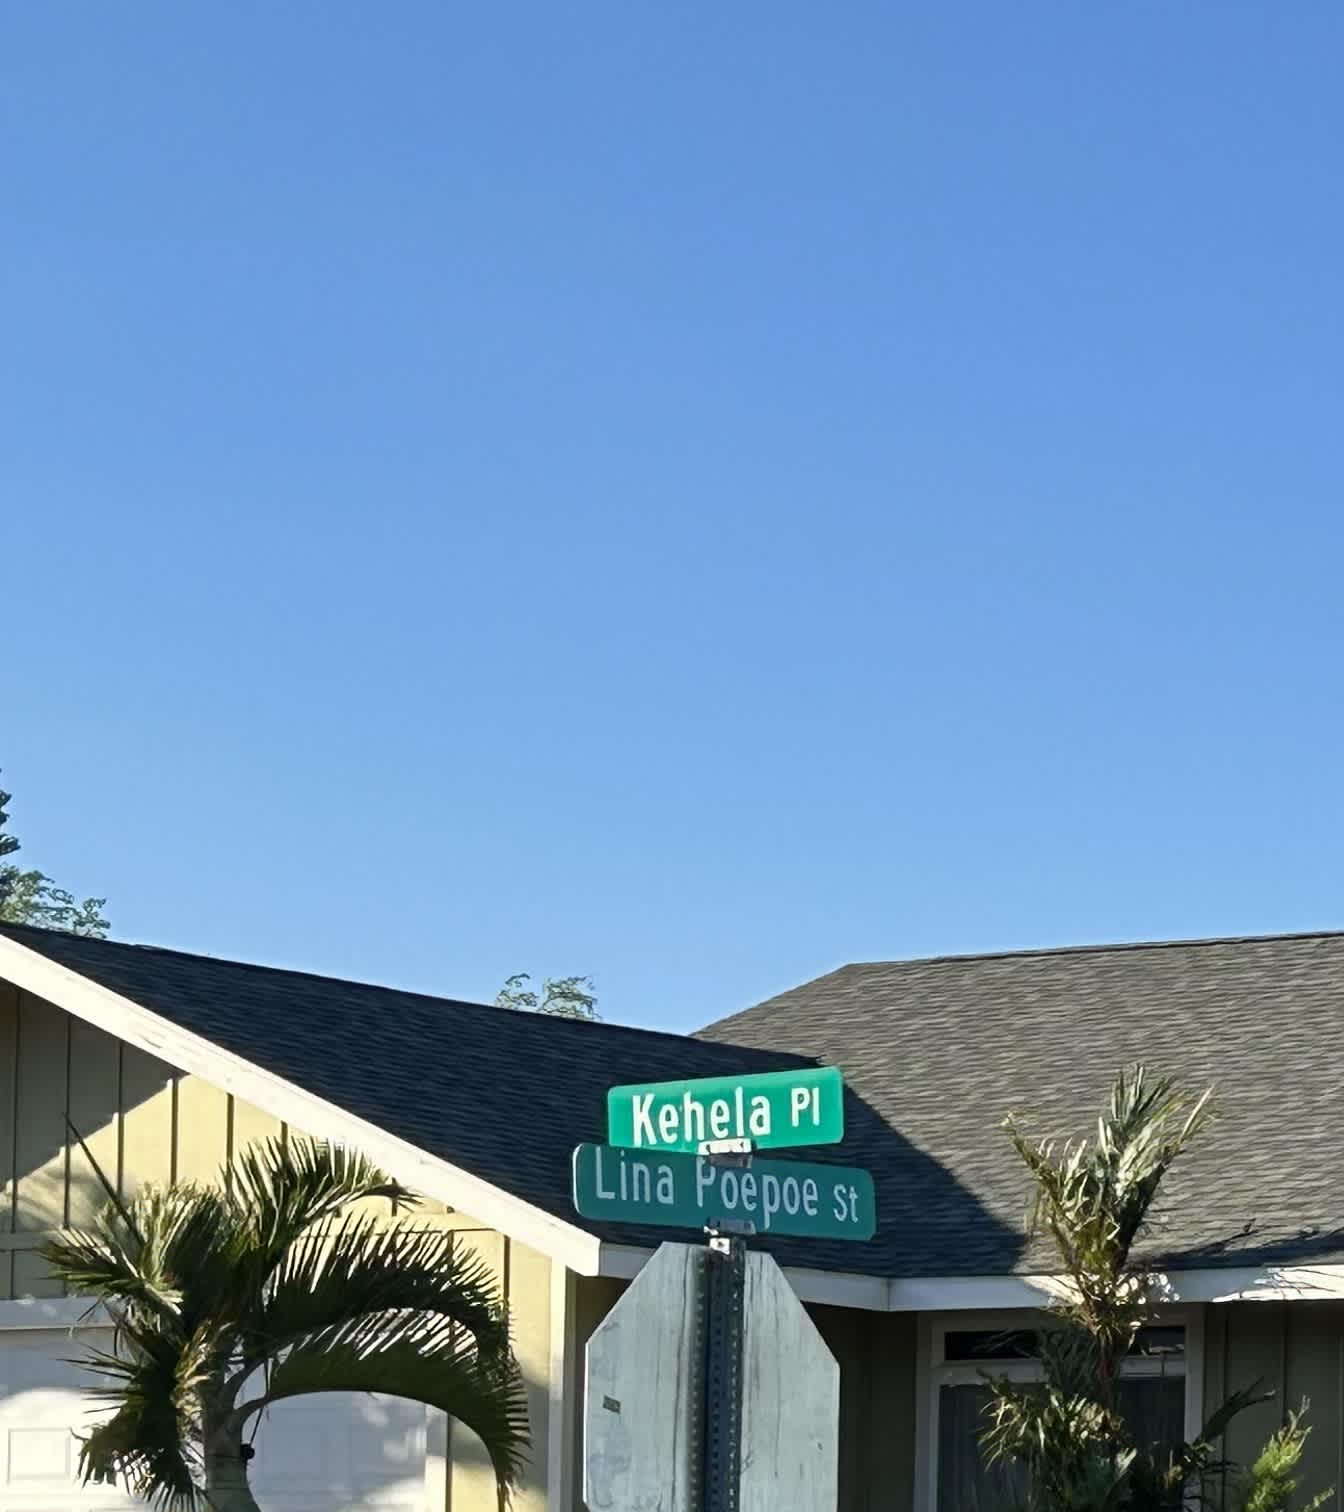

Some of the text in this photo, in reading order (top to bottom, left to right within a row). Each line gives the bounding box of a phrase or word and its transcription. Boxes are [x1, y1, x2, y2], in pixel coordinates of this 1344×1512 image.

[632, 1086, 820, 1147] Kehela Pl
[595, 1146, 859, 1230] Lina Poepoe St
